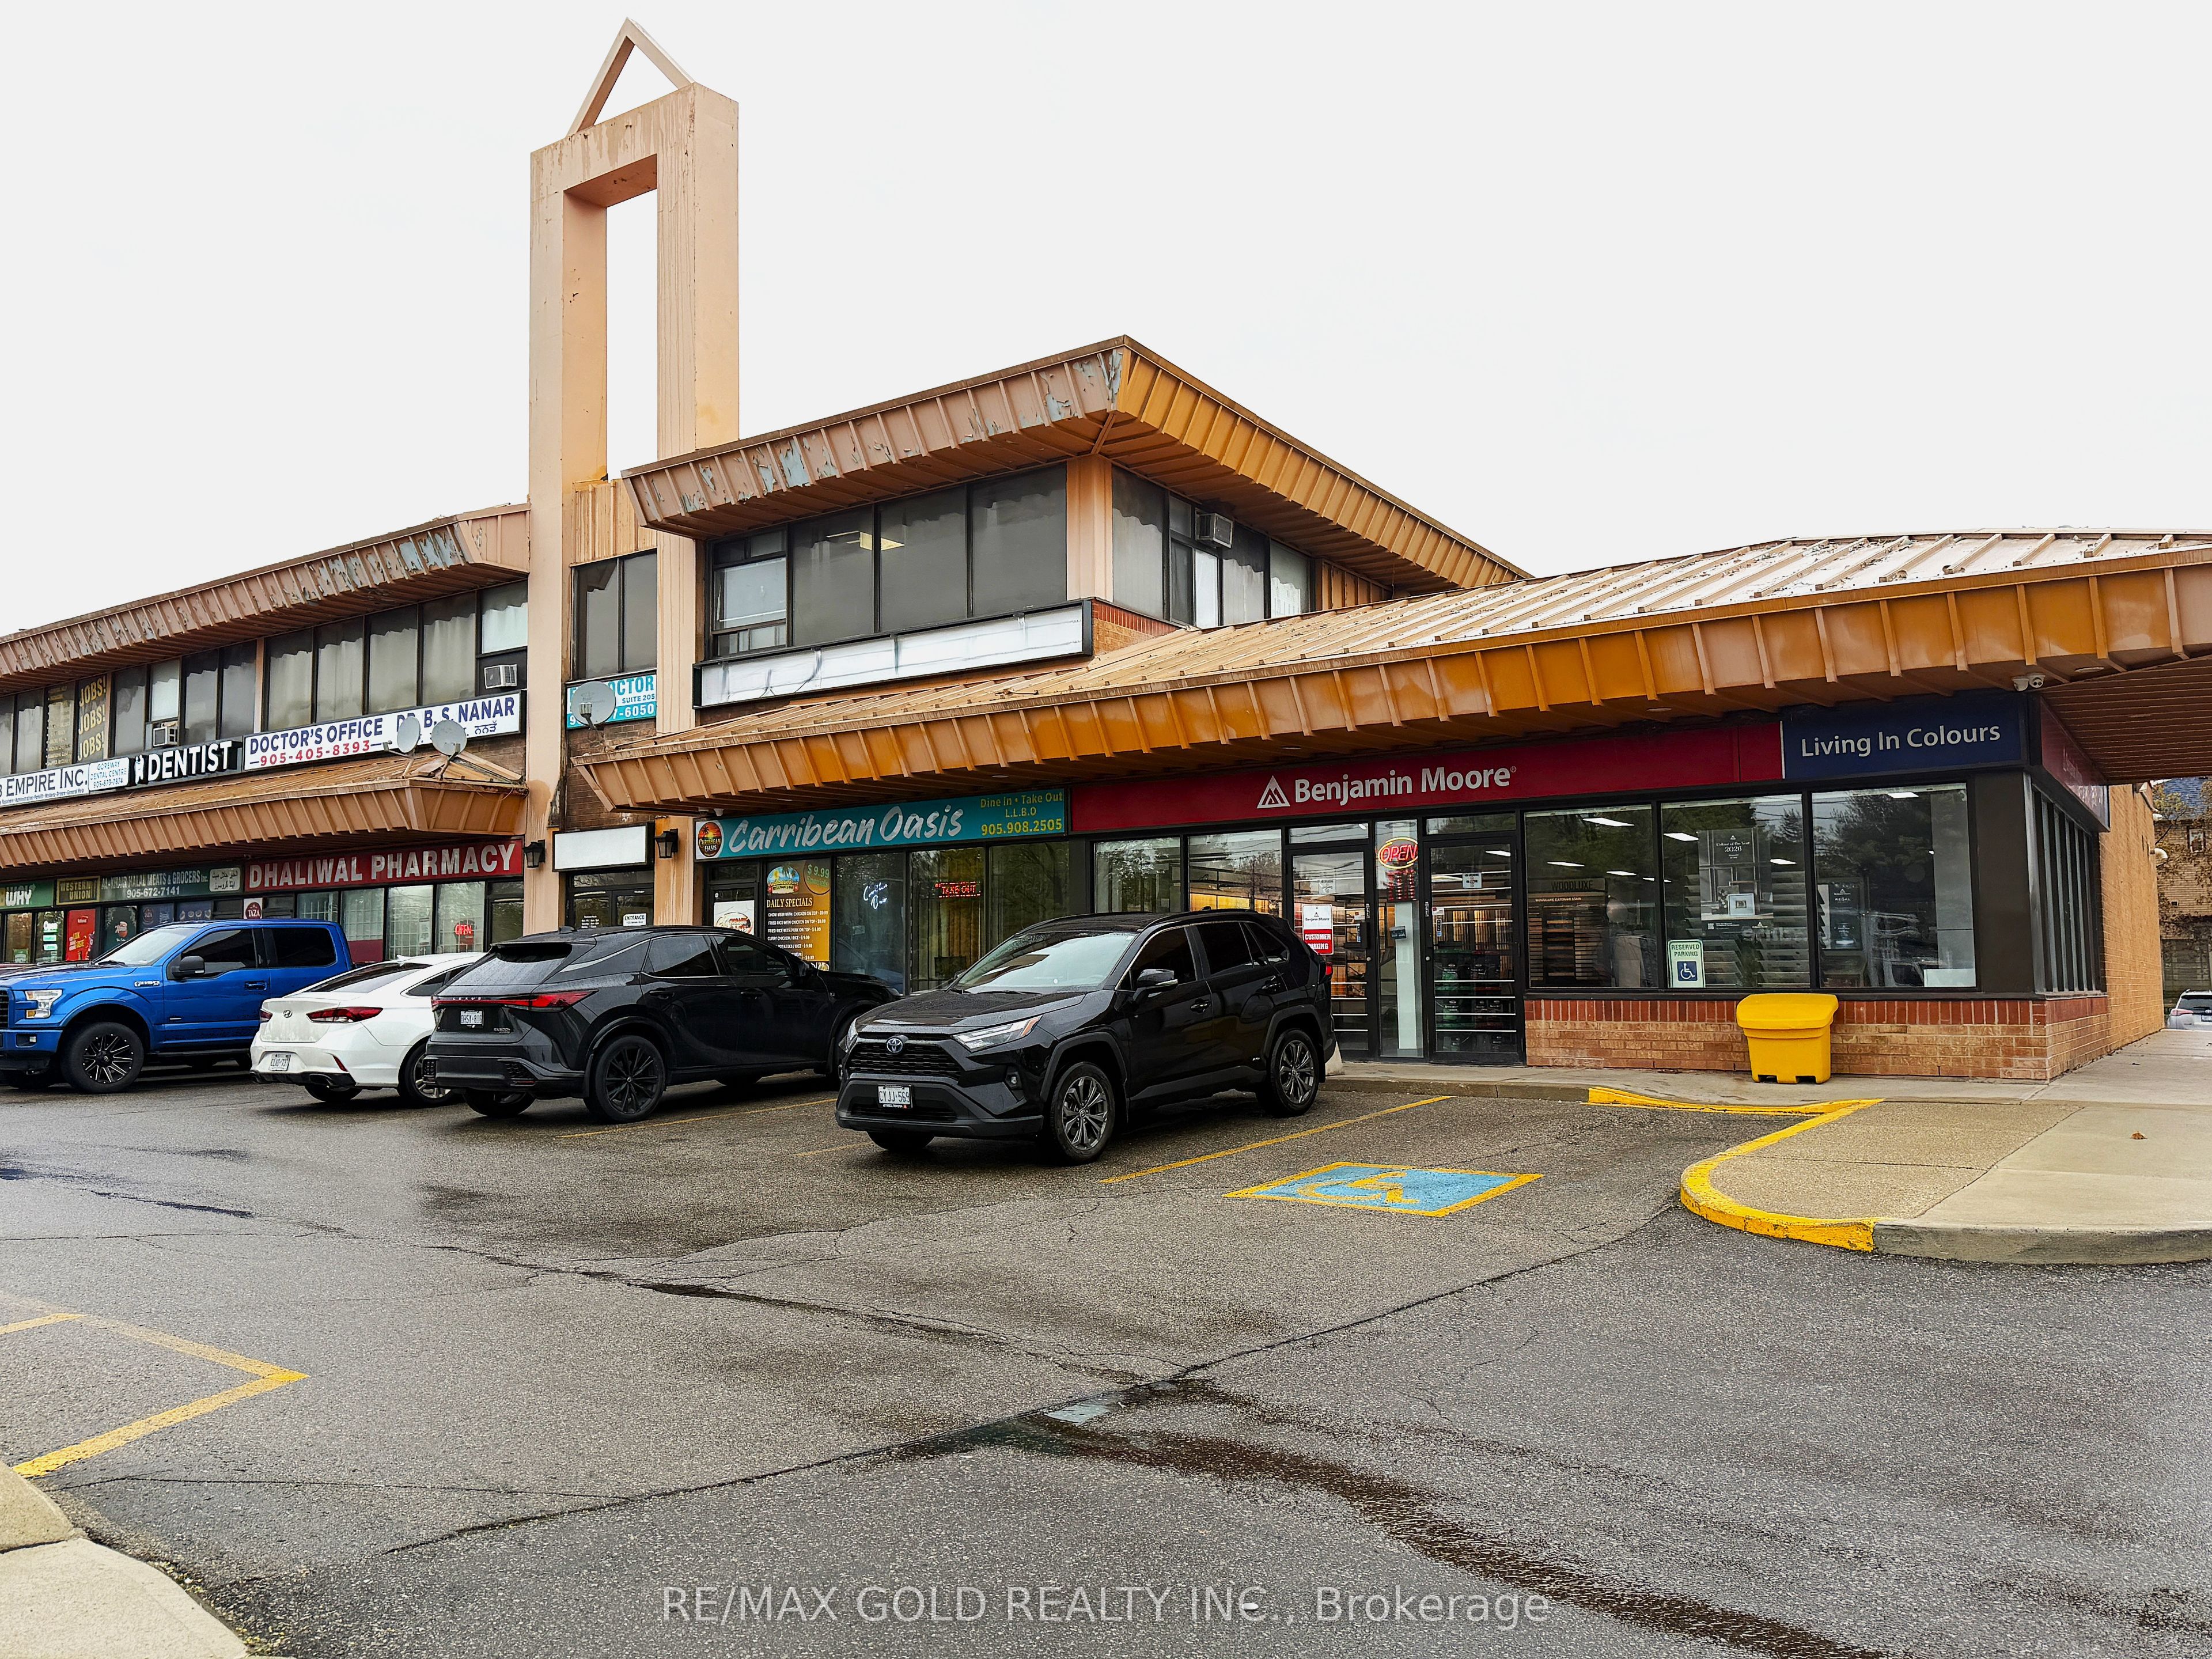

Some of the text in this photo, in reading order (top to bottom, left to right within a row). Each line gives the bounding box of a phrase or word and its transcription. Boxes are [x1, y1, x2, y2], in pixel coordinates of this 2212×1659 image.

[79, 676, 106, 707] JOBS!
[608, 675, 654, 696] OCTOR
[622, 696, 641, 704] SUITE
[78, 704, 105, 735] JOBS!
[249, 726, 323, 755] DOCTOR'S
[327, 718, 383, 743] OFFICE
[459, 697, 515, 724] NANAR
[77, 730, 105, 762] JOBS!
[1801, 723, 2001, 758] Living In Colours
[148, 740, 232, 782] DENTIST
[6, 772, 56, 797] EMPIRE
[59, 768, 88, 789] INC.
[1295, 770, 1412, 806] Benjamin
[980, 792, 1063, 808] Dine In Take Out
[729, 805, 964, 853] Carribean Oasis
[981, 818, 1062, 836] 905.908.2505
[1381, 844, 1418, 863] OPEN
[249, 843, 515, 889] DHALIWAL PHARMACY
[60, 880, 91, 892] WESTERN
[128, 874, 145, 888] HALAL
[147, 873, 166, 886] MEATS
[172, 870, 200, 884] GROCERS
[961, 885, 976, 893] OUT
[1551, 880, 1593, 891] WOODLUXE
[69, 890, 90, 900] UNION
[767, 897, 813, 908] DAILY SPECIALS
[454, 924, 472, 935] OPEN
